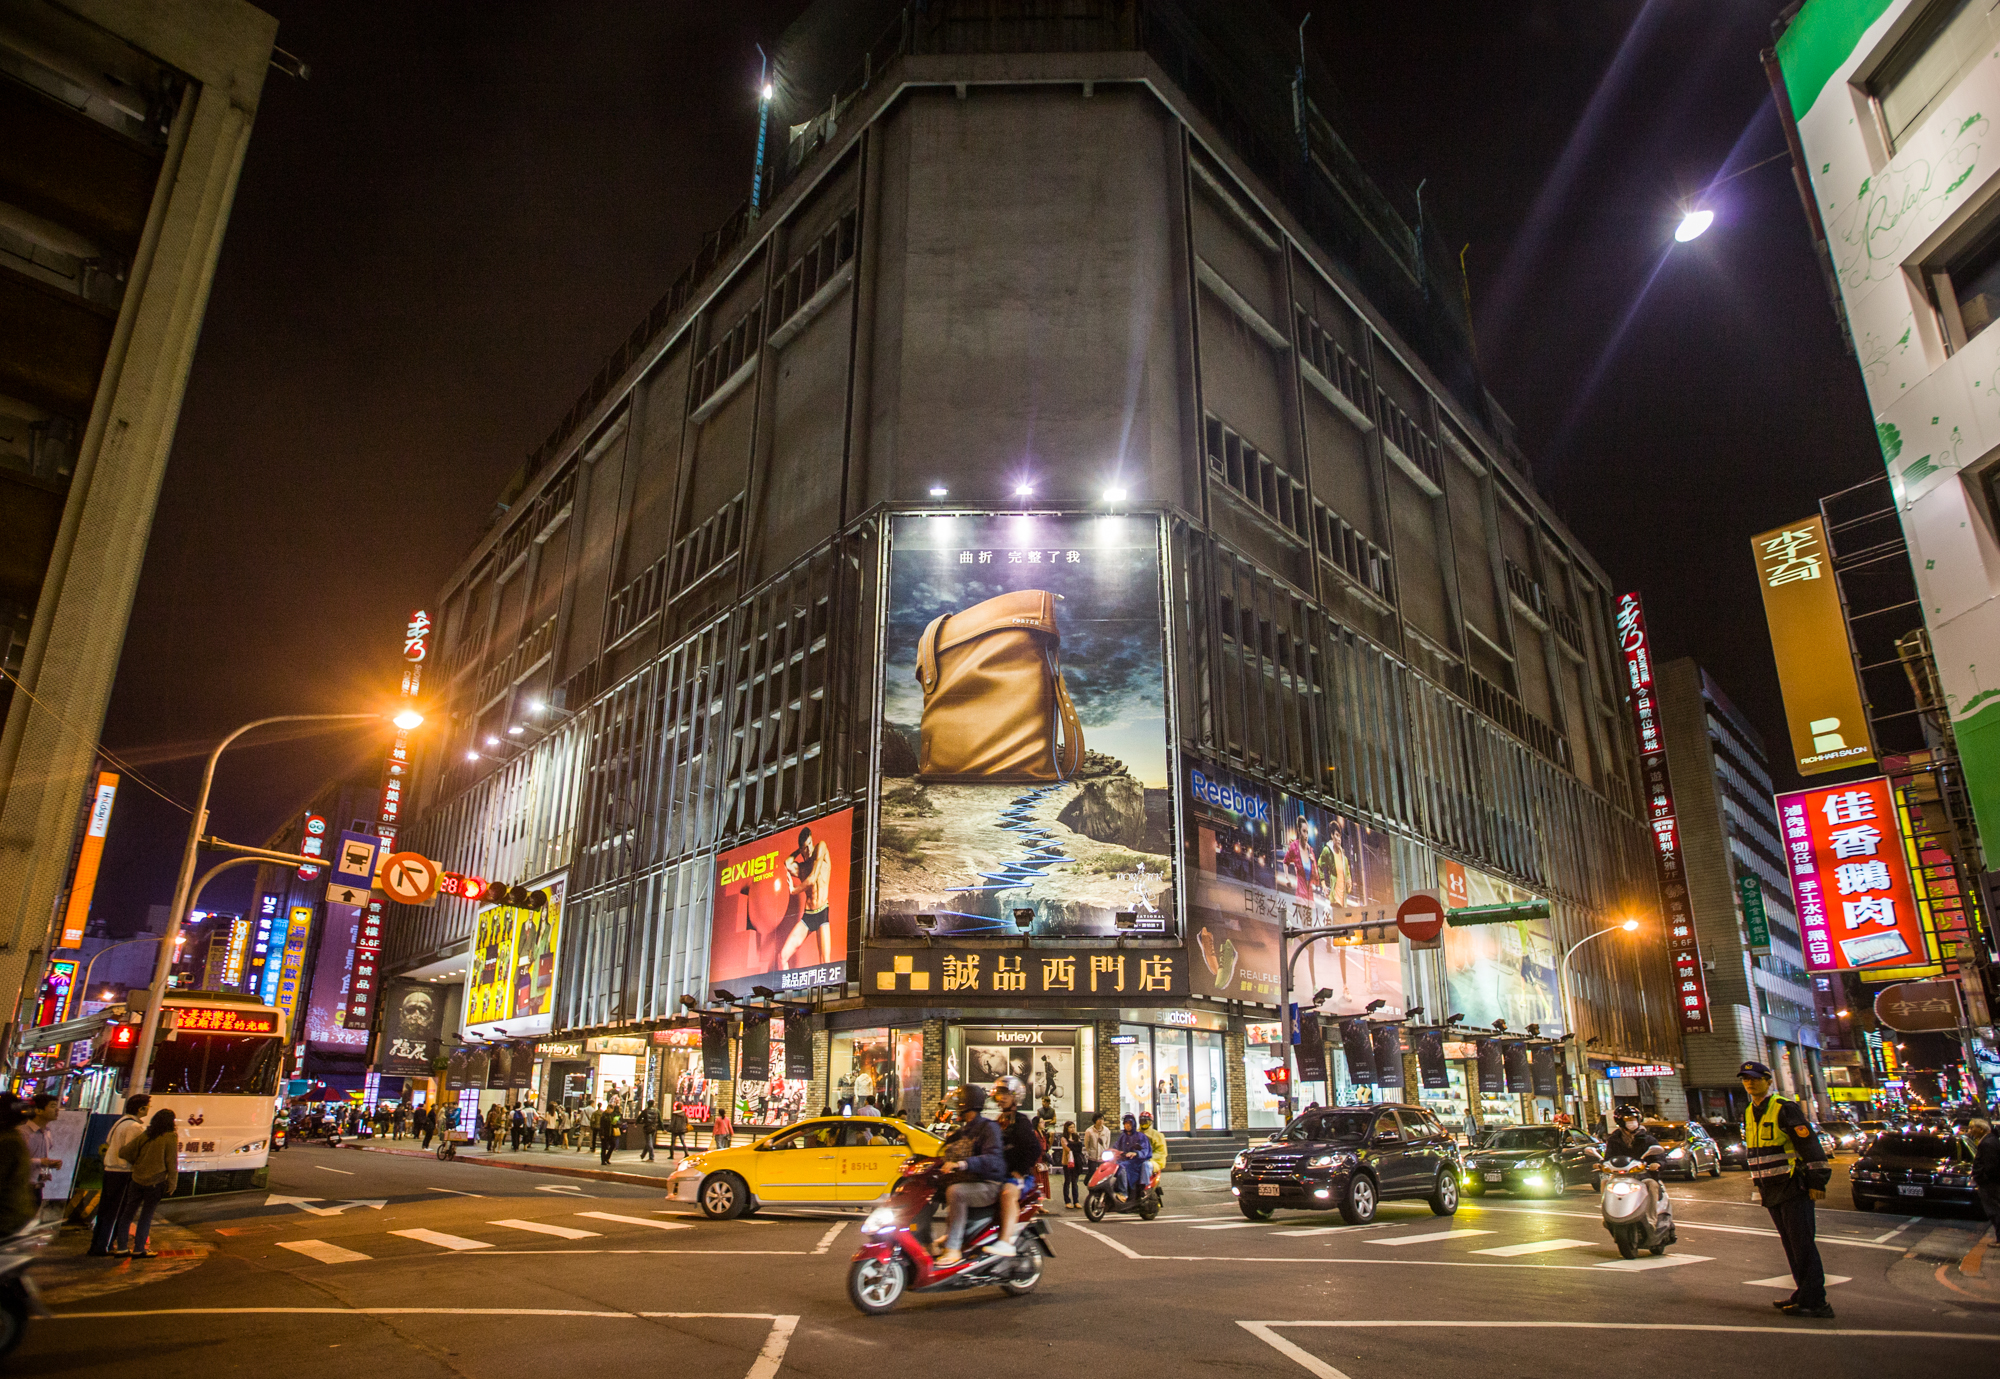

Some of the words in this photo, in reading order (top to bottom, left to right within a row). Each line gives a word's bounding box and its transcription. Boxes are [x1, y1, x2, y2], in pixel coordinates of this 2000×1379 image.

[959, 551, 993, 564] 曲折
[1008, 550, 1081, 564] 完整了我
[1760, 526, 1823, 588] 李奇
[1012, 618, 1040, 626] PORTER
[1628, 660, 1641, 690] CINEMAS
[1636, 648, 1650, 684] SHOWTIME
[1636, 687, 1659, 751] 今日數位影城
[1838, 746, 1868, 757] SALON
[384, 779, 401, 814] 遊樂場
[1191, 769, 1270, 823] Reebok
[1649, 770, 1668, 807] 遊樂場
[382, 813, 396, 822] 8F
[1654, 807, 1669, 818] 8F
[1783, 804, 1808, 840] 滷肉飯
[720, 851, 779, 887] 2(X)IST
[1658, 831, 1677, 871] 新利大雅
[1790, 840, 1815, 876] 切仔麵
[1821, 791, 1898, 930] 佳香鵝肉
[440, 876, 458, 894] 28
[753, 875, 763, 883] NEW
[762, 871, 774, 879] YORK
[364, 902, 382, 938] 香滿樓
[1292, 902, 1333, 928] 不落人後
[1798, 880, 1825, 927] 手工水餃
[359, 938, 380, 947] 5.6F
[1807, 929, 1831, 965] 黑白切
[352, 965, 373, 1017] 誠品商場
[781, 967, 827, 989] 誠品西門店
[829, 967, 842, 981] 2F
[943, 954, 1174, 992] 誠品西門店
[1679, 966, 1701, 1020] 誠品商場
[1156, 1011, 1193, 1025] swatch
[538, 1043, 569, 1058] Hurley
[996, 1032, 1030, 1044] Hurley
